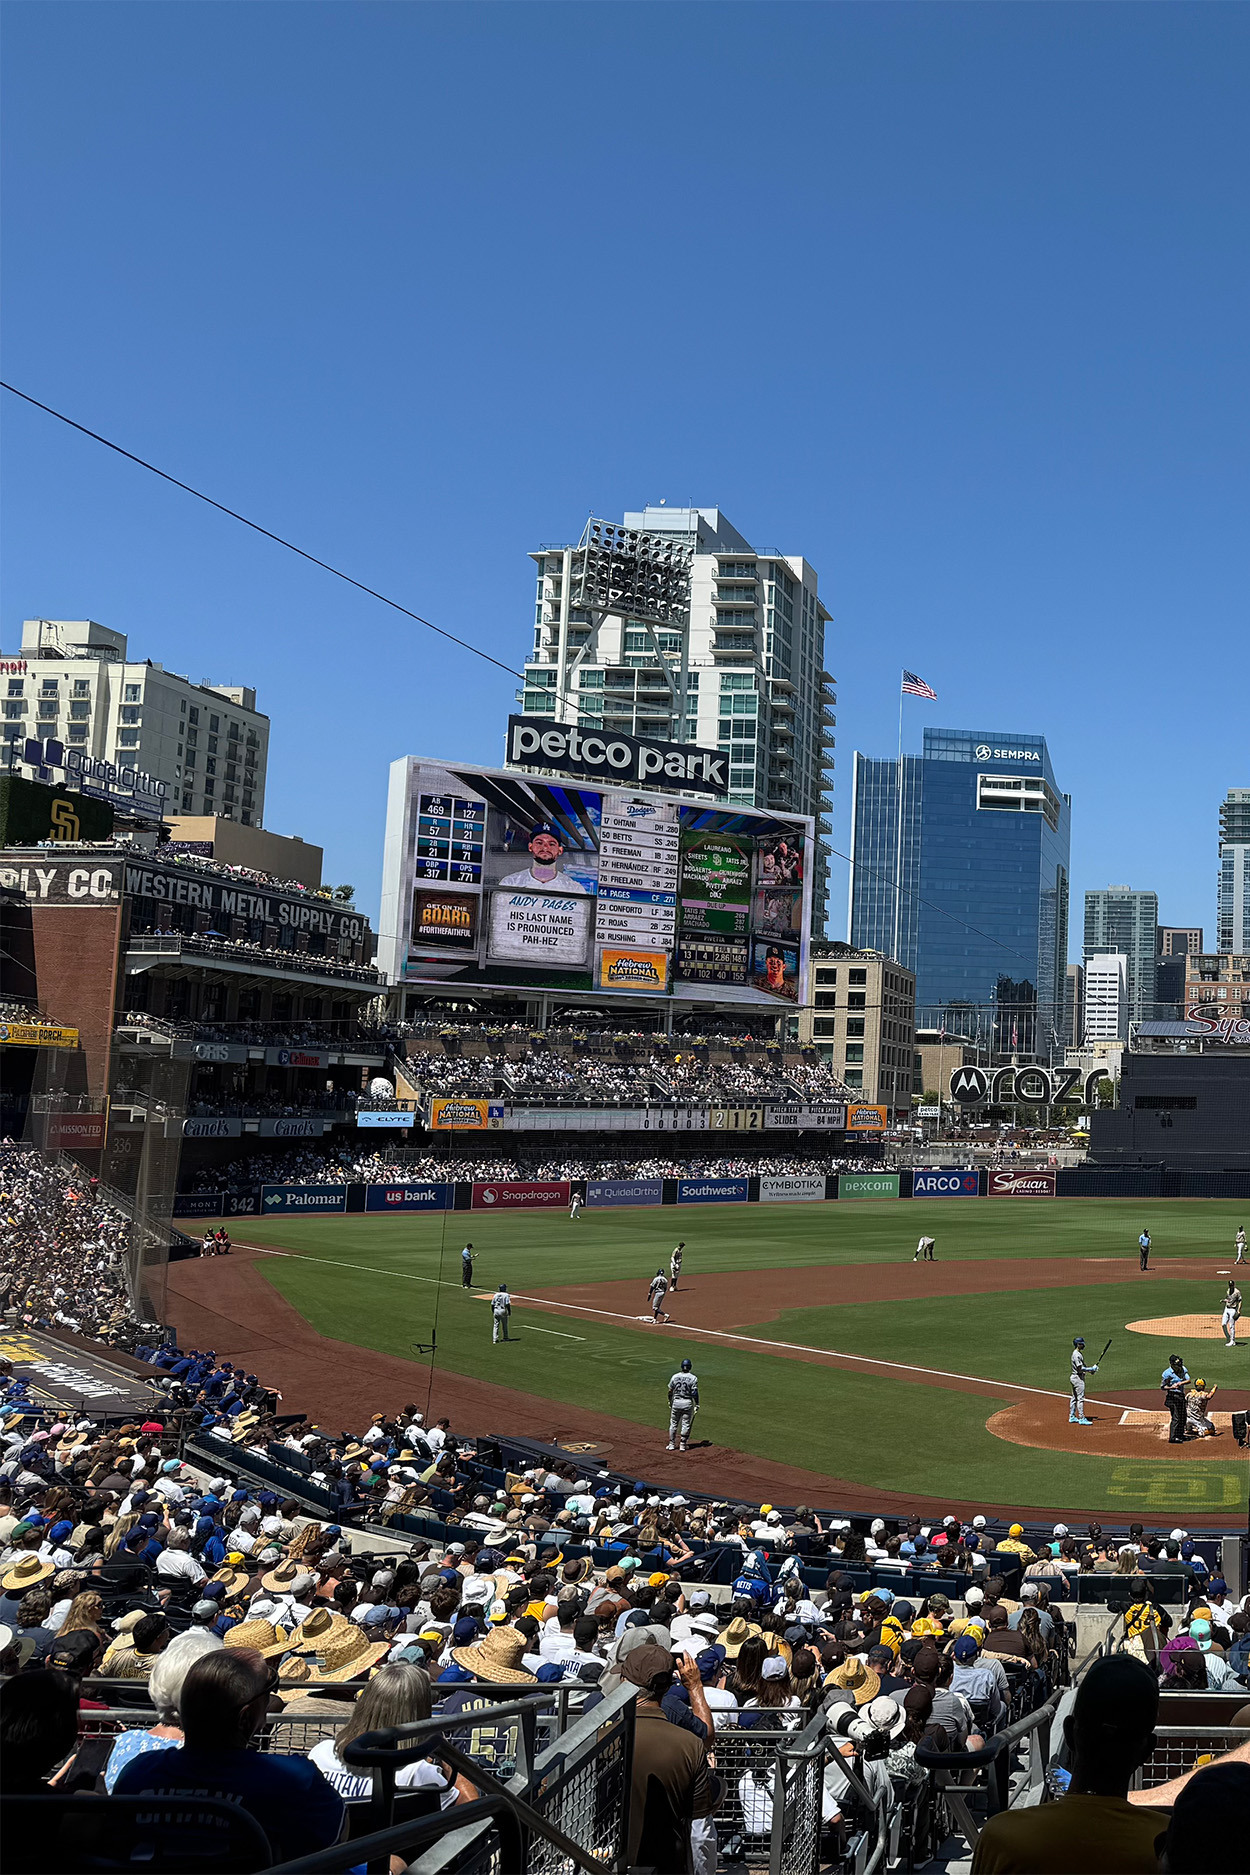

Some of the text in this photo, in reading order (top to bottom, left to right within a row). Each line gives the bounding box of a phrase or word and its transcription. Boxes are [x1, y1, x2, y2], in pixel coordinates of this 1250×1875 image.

[512, 725, 726, 785] petco park
[993, 749, 1040, 761] SEMPRA
[65, 749, 166, 798] QuidelOrtho
[427, 805, 444, 815] 469
[463, 810, 476, 819] 127
[626, 805, 657, 817] Dodgers
[613, 819, 637, 828] OHTANI
[429, 827, 440, 836] 57
[464, 831, 472, 840] 21
[613, 833, 633, 841] BETTS
[429, 848, 438, 857] 21
[612, 847, 641, 857] FREEMAN
[704, 844, 732, 853] LAUREANO
[463, 852, 471, 860] 71
[424, 869, 440, 878] .317
[458, 873, 473, 882] .771
[683, 873, 709, 881] MACHADO
[68, 869, 119, 899] CO.
[610, 876, 643, 886] FREELAND
[610, 890, 630, 899] PAGES
[651, 894, 660, 902] CF
[126, 867, 363, 941] WESTERN METAL SUPPLY CO.
[509, 896, 577, 911] ANDY PAGES
[609, 905, 642, 914] CONFORTO
[422, 908, 470, 928] BOARD
[510, 911, 573, 925] HIS LAST NAME
[608, 919, 628, 927] ROJAS
[419, 927, 471, 937] #FORTHEFAITHFUL
[507, 923, 574, 936] IS PRONOUNCED
[522, 935, 558, 946] PAH-HEZ
[608, 933, 636, 943] RUSHING
[684, 951, 691, 959] 13
[732, 955, 746, 963] 148.0
[616, 959, 652, 969] Hebrew
[610, 966, 657, 978] NATIONAL
[682, 968, 691, 977] 47
[698, 970, 710, 978] 102
[717, 971, 726, 979] 40
[733, 972, 744, 980] 155
[39, 1029, 63, 1041] PORCH
[290, 1052, 320, 1066] Calimax
[991, 1065, 1109, 1105] razr
[445, 1103, 475, 1111] Hebrew
[439, 1110, 480, 1119] NATIONAL
[851, 1113, 881, 1121] NATIONAL
[774, 1115, 798, 1125] SLIDER
[827, 1116, 840, 1125] MPH
[59, 1125, 101, 1134] MISSION FED
[182, 1119, 229, 1137] Canel's
[273, 1119, 315, 1136] Canel's
[113, 1138, 131, 1153] 336
[762, 1180, 823, 1190] CYMBIOTIKA
[915, 1177, 960, 1191] ARCO
[992, 1173, 1050, 1193] Sycuan
[387, 1190, 436, 1201] us bank
[502, 1190, 561, 1201] Snapdragon
[604, 1187, 659, 1198] QuidelOrtho
[682, 1185, 737, 1196] Southwest
[285, 1193, 343, 1205] Palomar
[230, 1197, 255, 1212] 342
[737, 1580, 753, 1590] BETTS
